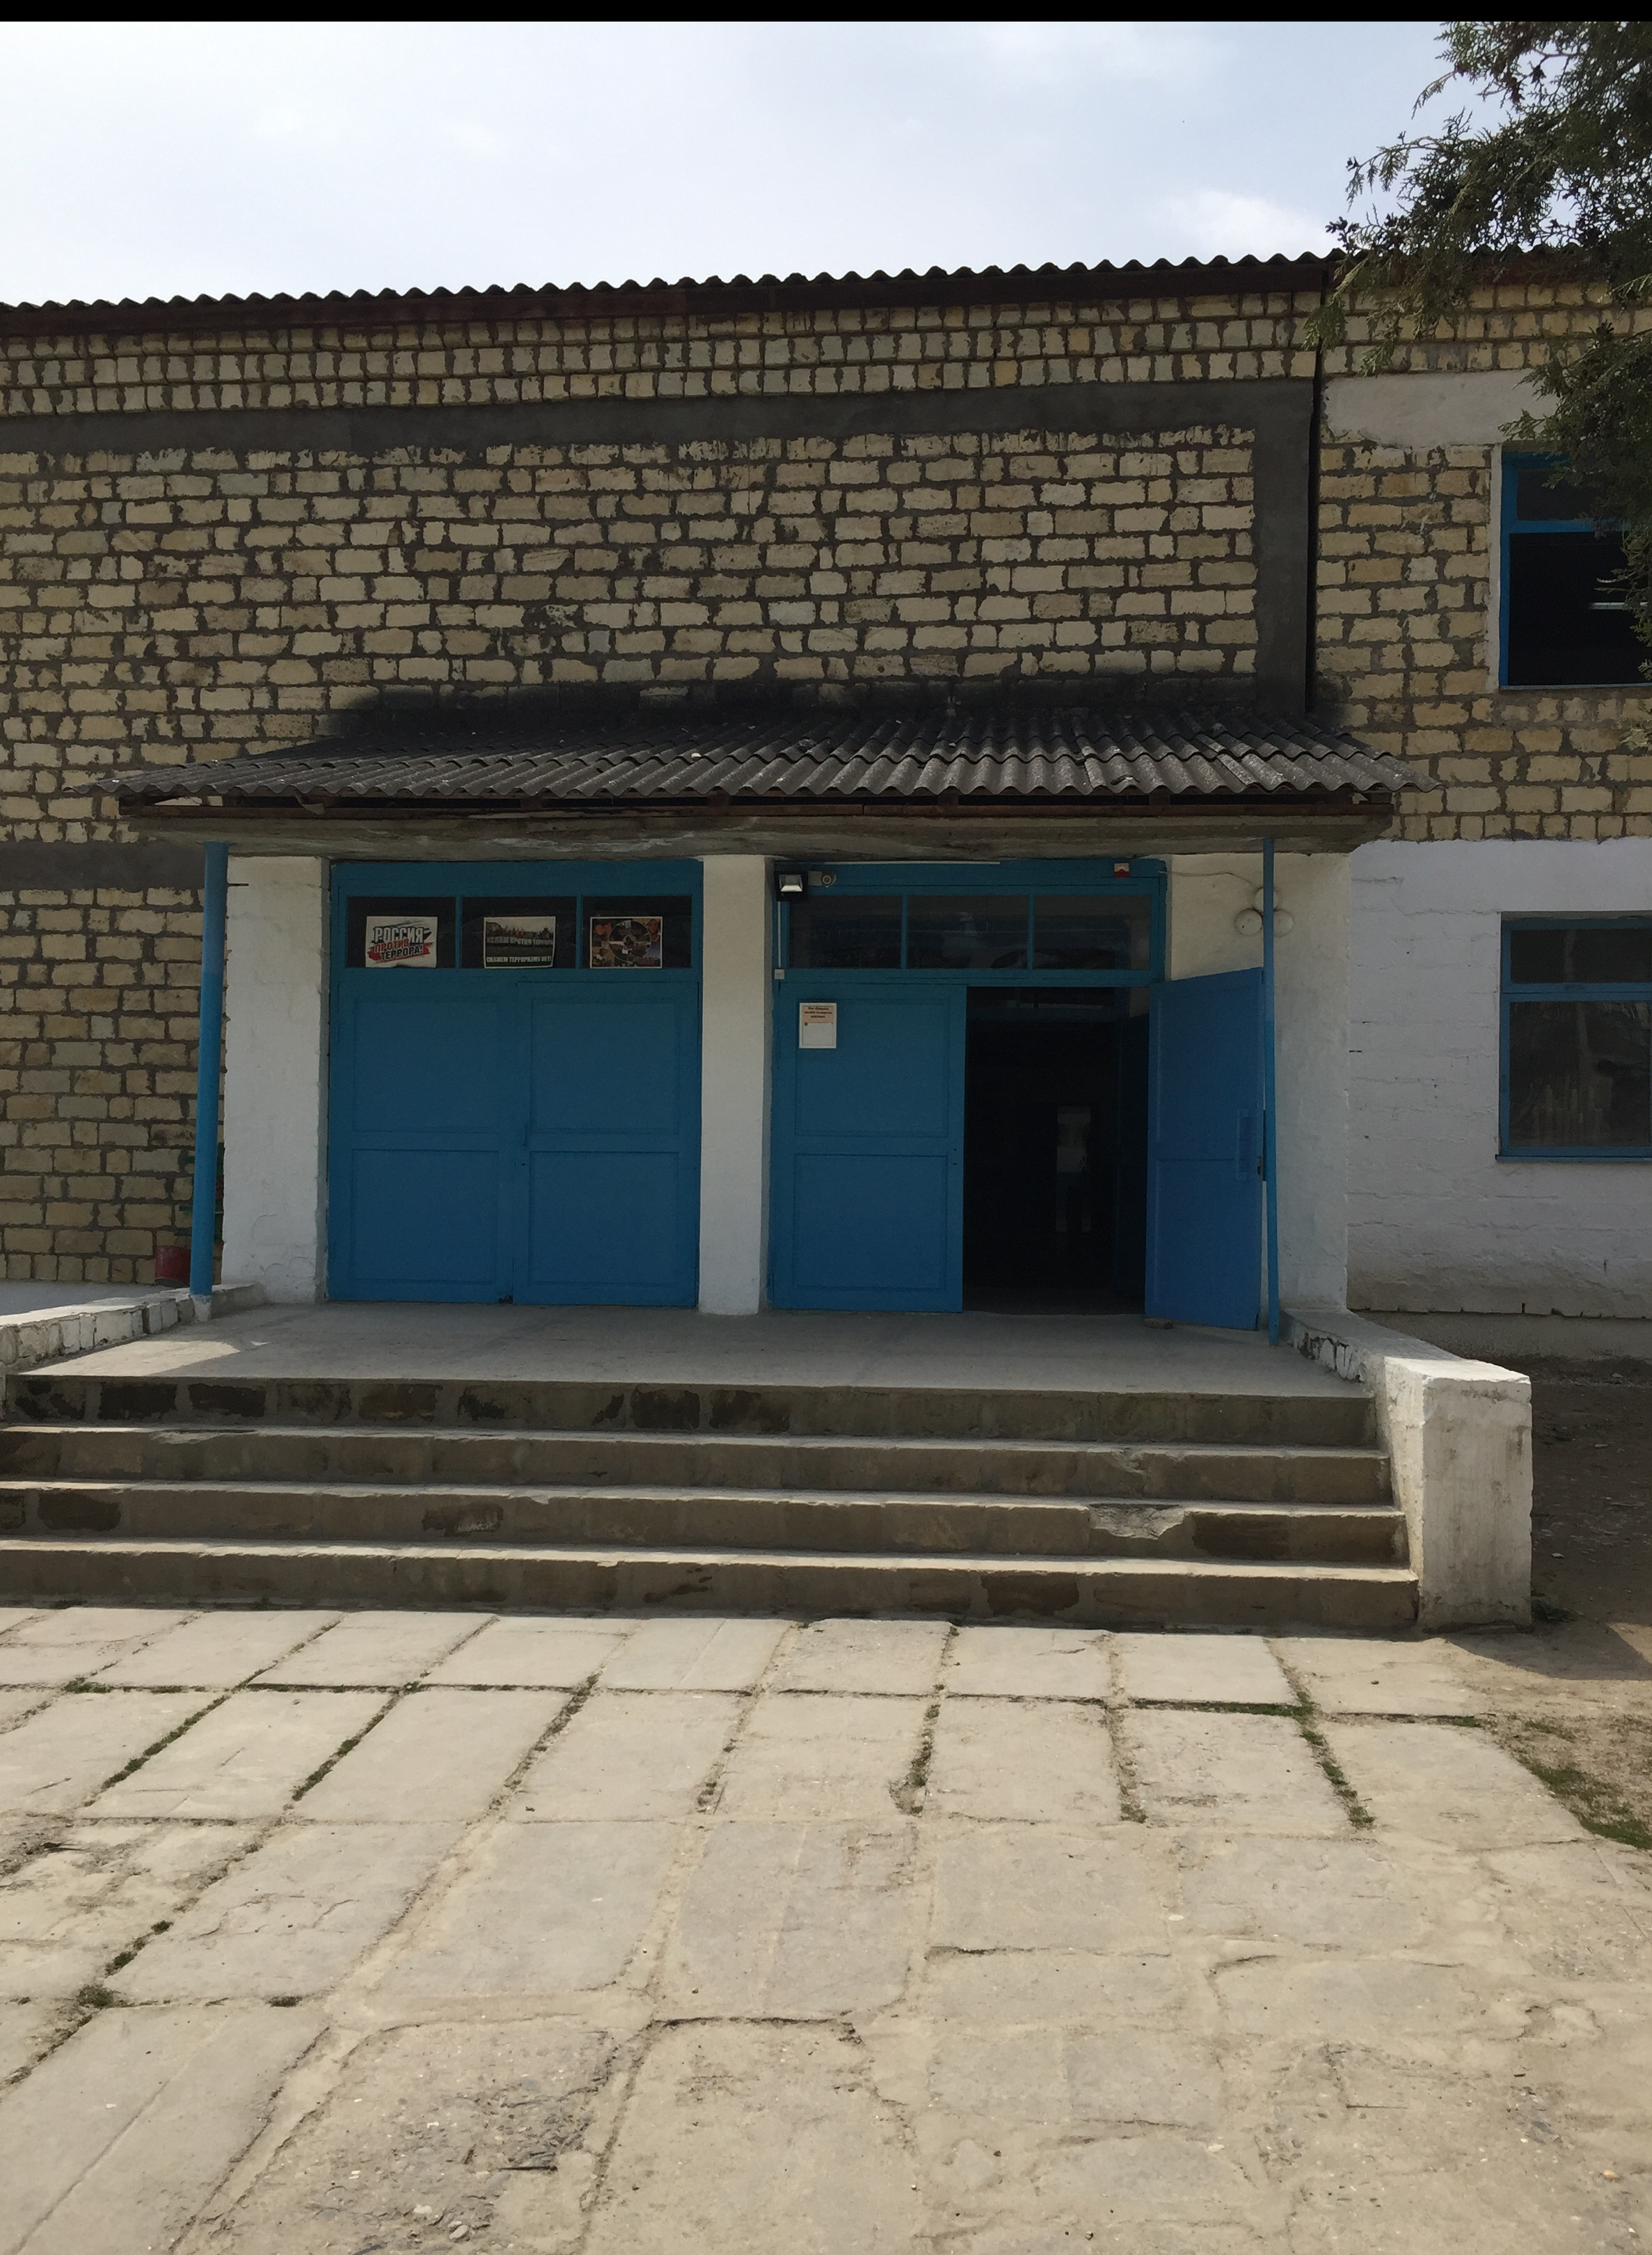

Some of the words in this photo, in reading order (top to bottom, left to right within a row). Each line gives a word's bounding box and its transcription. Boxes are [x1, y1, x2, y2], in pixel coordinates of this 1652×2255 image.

[374, 926, 424, 943] РОССИЯ
[374, 938, 409, 952] ПРОТИВ
[381, 945, 423, 960] ТЕРРОРА!
